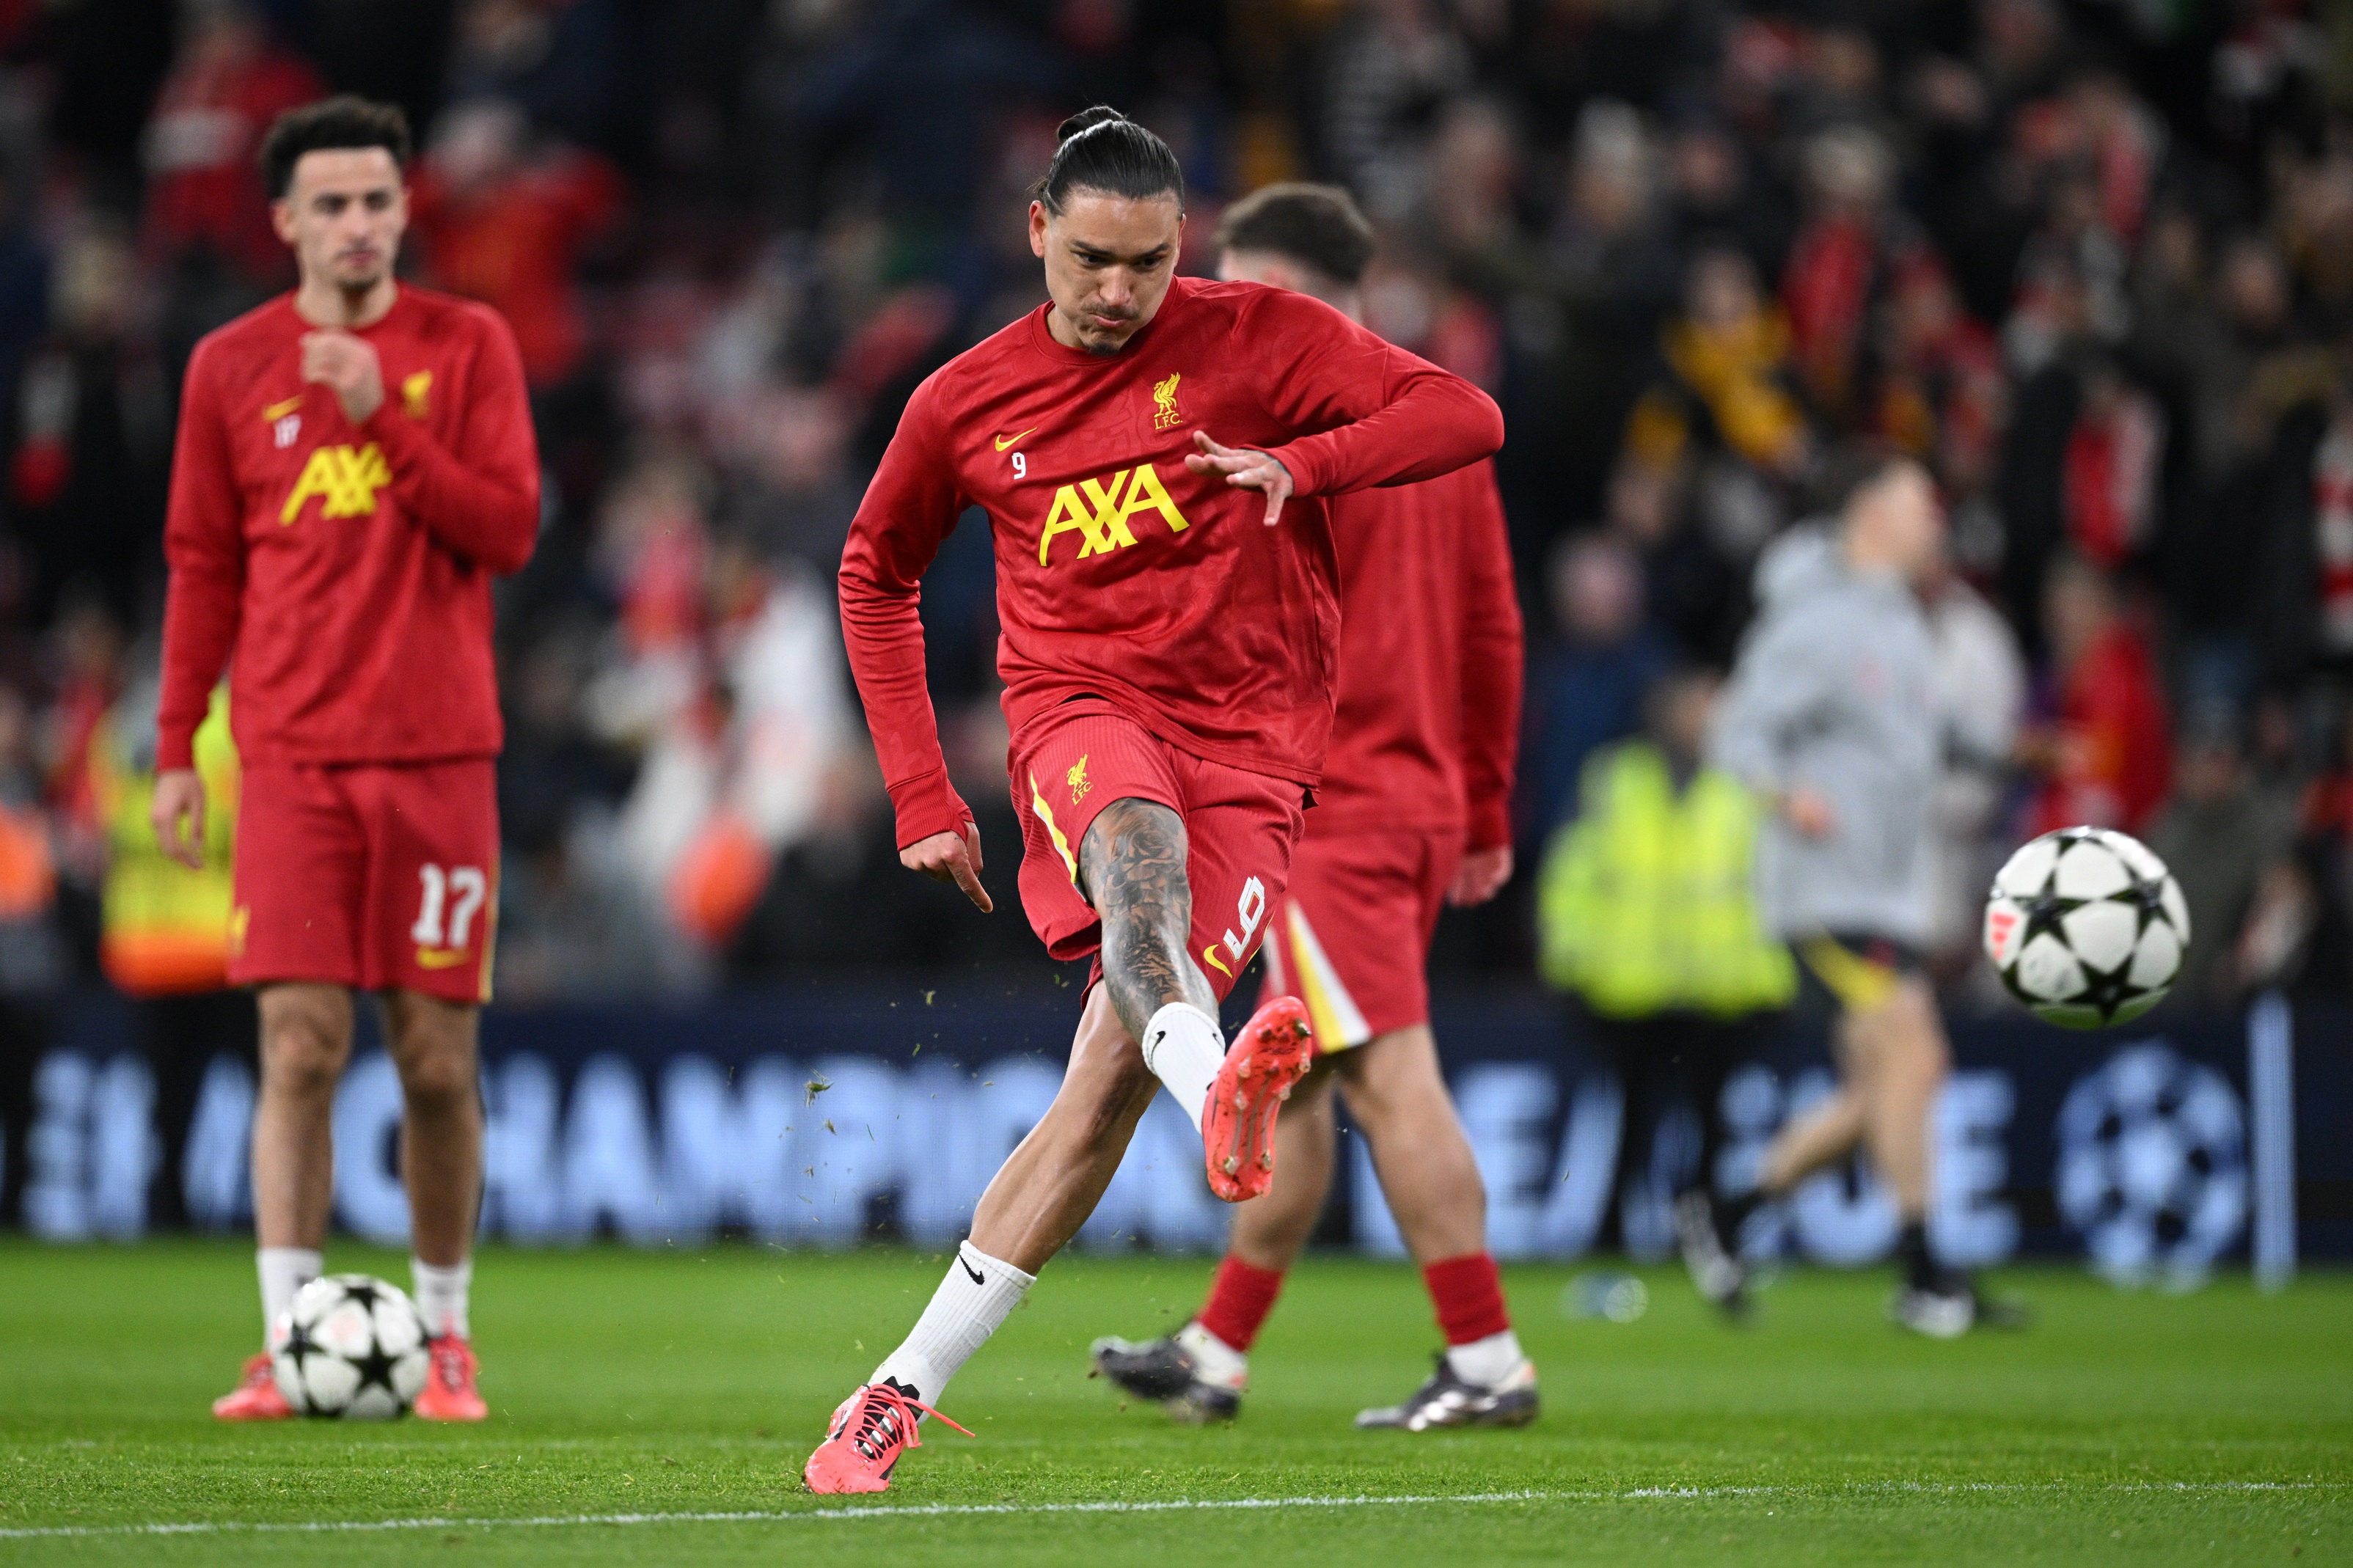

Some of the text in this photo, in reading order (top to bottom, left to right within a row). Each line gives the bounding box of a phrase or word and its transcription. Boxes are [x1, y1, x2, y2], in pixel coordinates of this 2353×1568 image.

[1154, 413, 1183, 430] L.F.C.
[1011, 452, 1026, 480] 9
[1039, 464, 1190, 566] AXA
[410, 862, 485, 948] 17
[1223, 875, 1265, 961] 9
